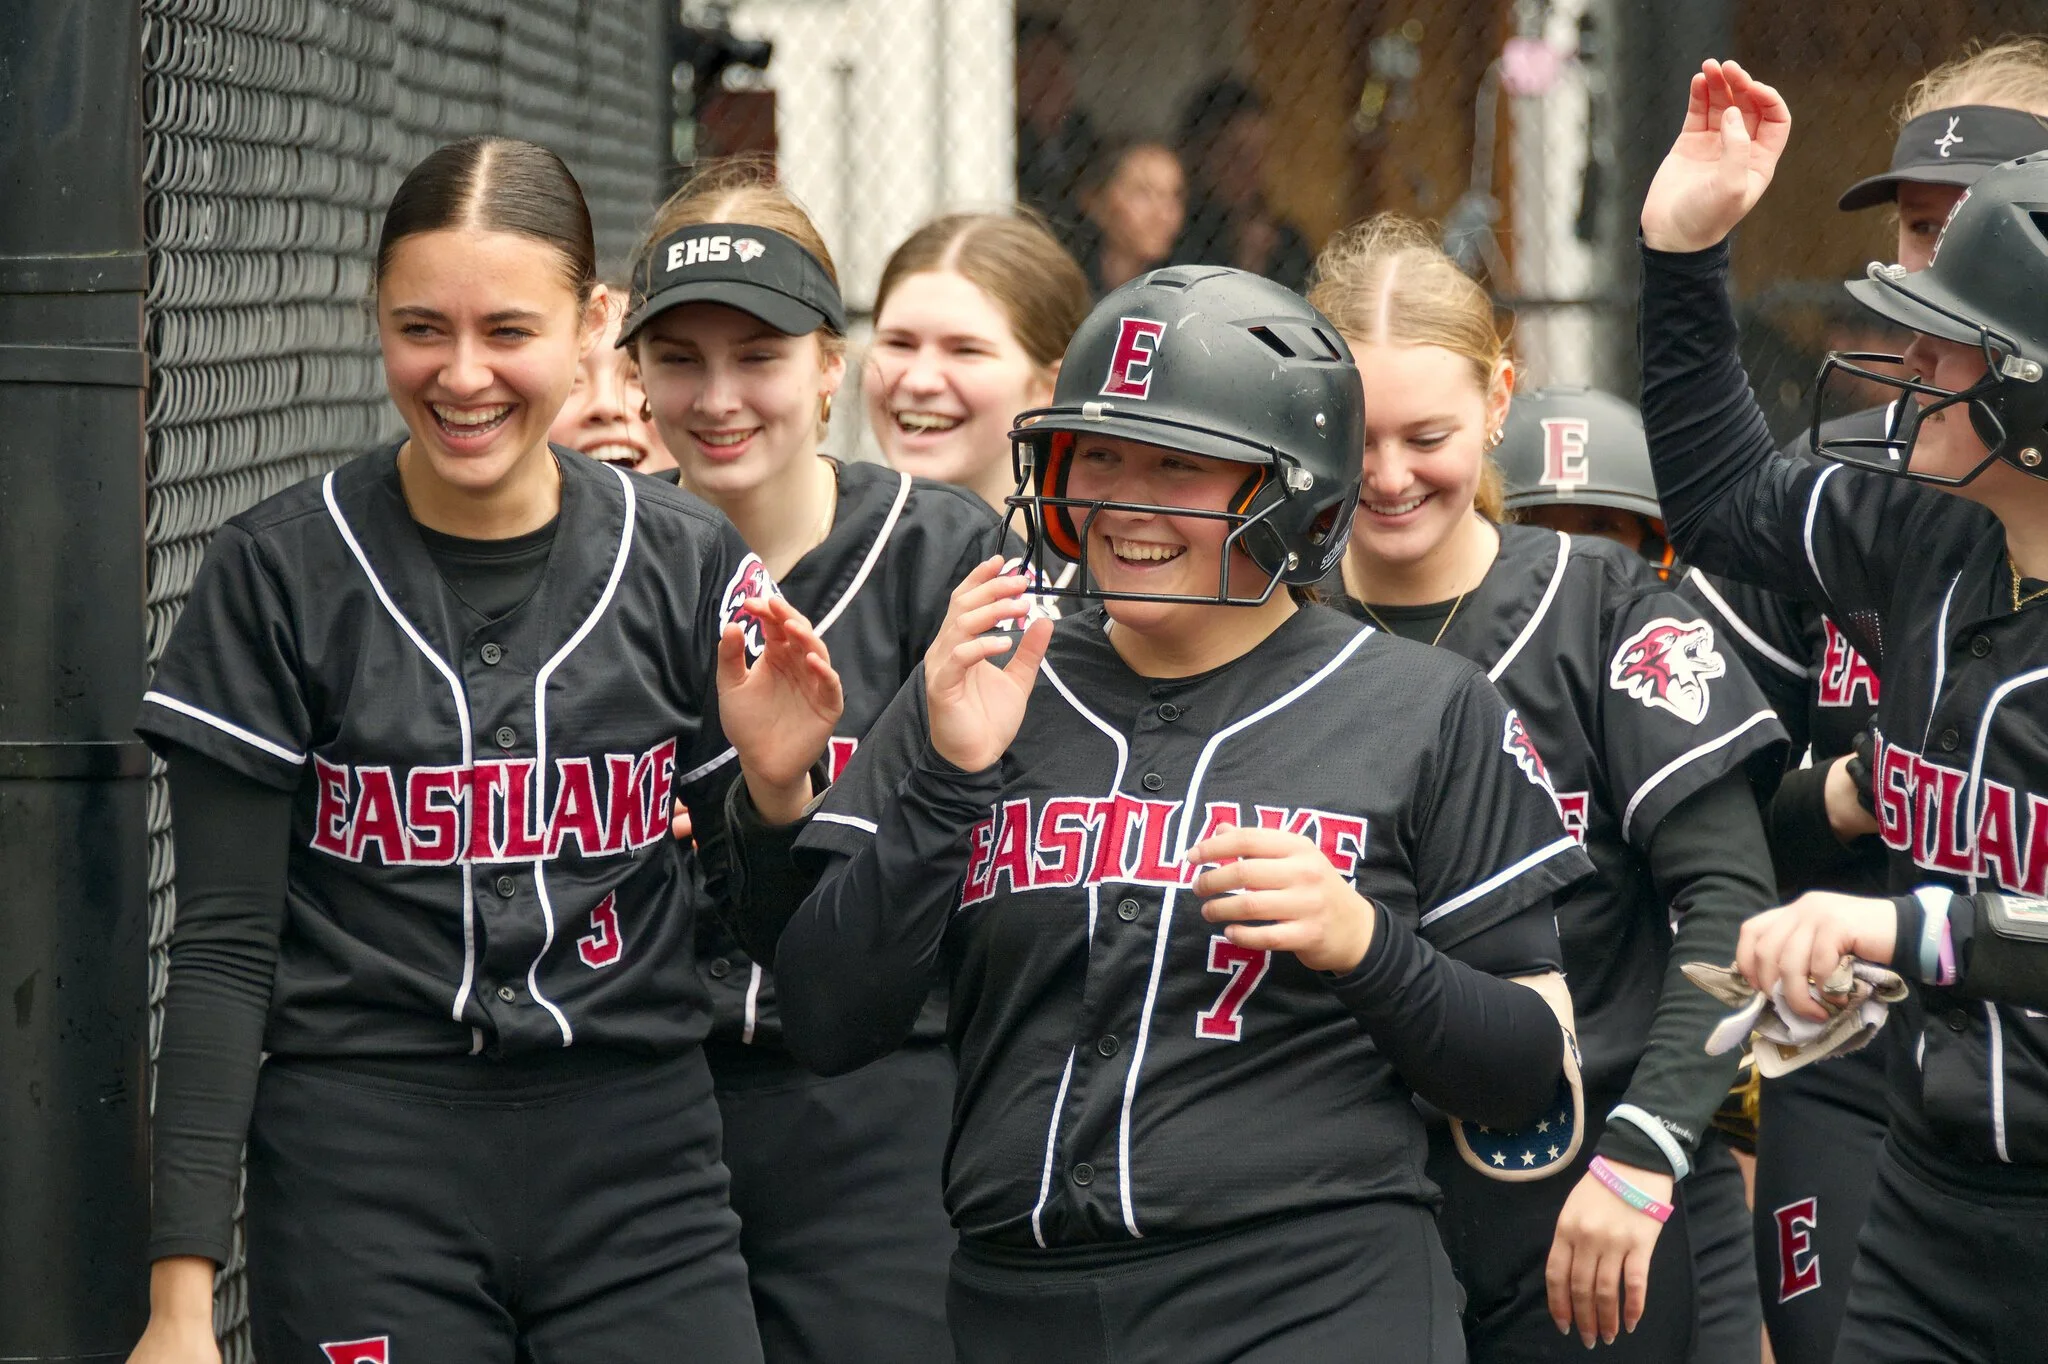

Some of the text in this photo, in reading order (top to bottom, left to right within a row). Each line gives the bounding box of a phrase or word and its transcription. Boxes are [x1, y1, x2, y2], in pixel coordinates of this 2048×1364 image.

[665, 236, 731, 272] EHS
[1099, 317, 1167, 400] E
[1538, 417, 1589, 486] E
[310, 736, 677, 867] EASTLAKE
[577, 889, 623, 970] 3
[1196, 934, 1271, 1042] 7
[1773, 1196, 1822, 1304] E
